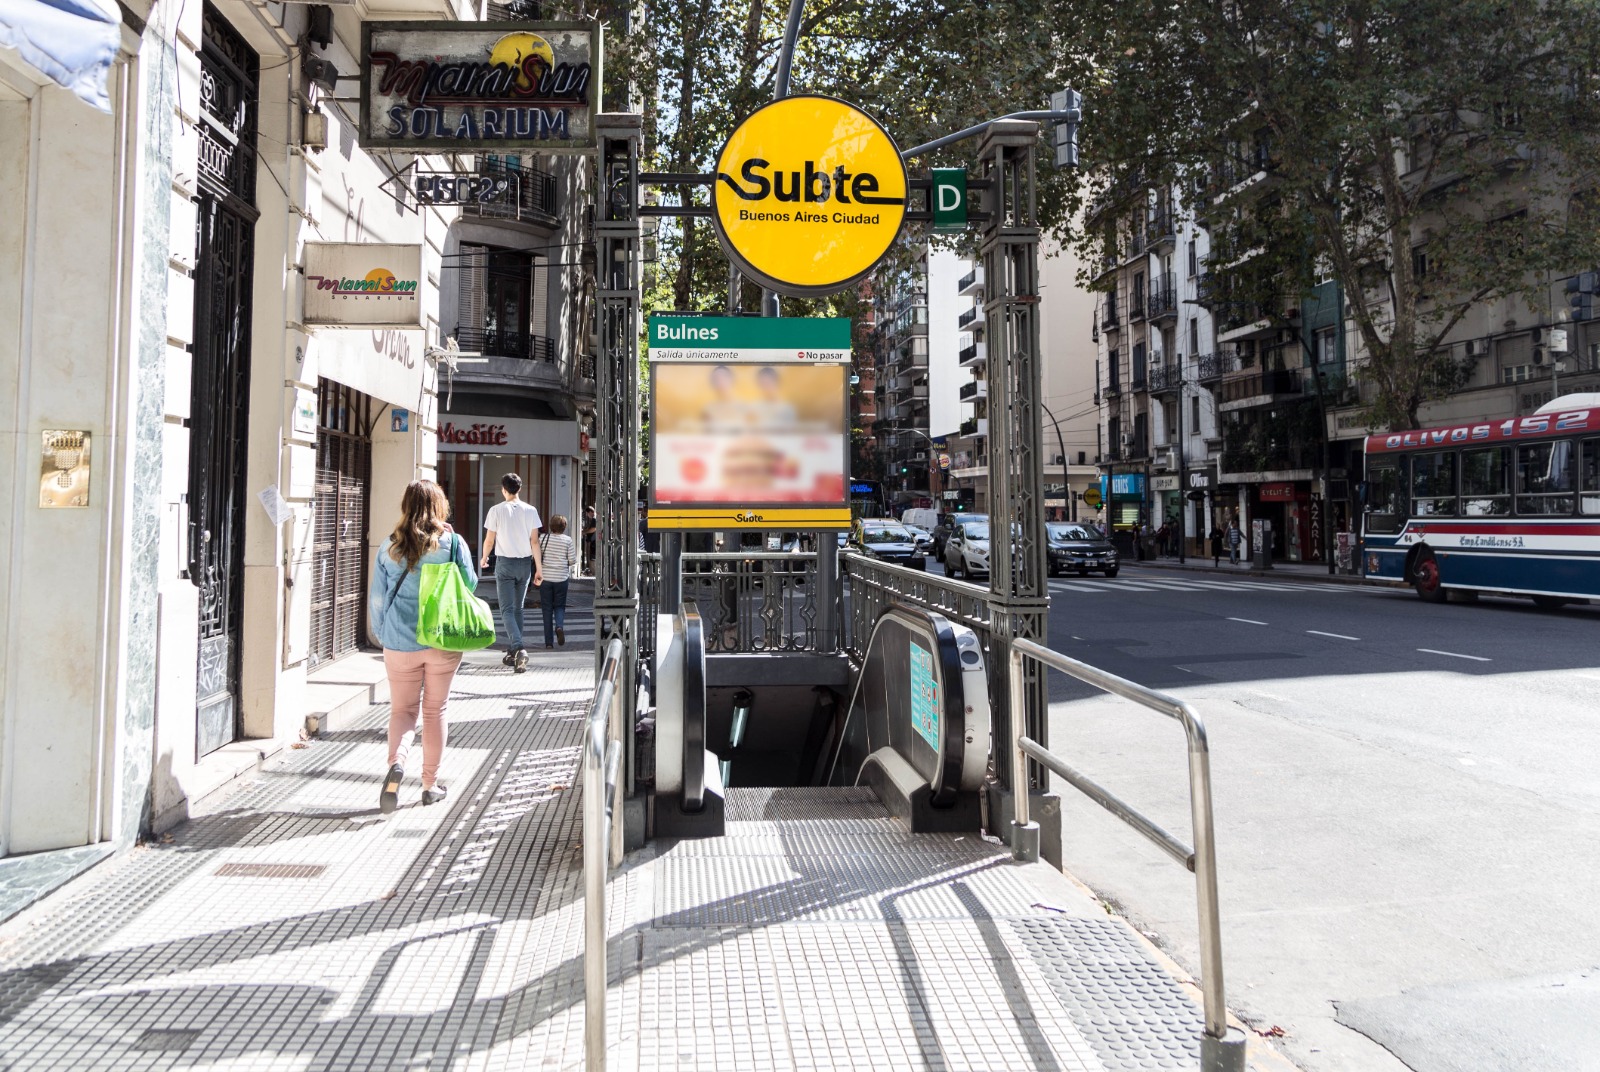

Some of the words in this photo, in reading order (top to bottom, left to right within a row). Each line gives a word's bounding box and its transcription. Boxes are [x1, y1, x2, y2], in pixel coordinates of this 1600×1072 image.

[513, 54, 591, 98] Sun
[387, 106, 571, 139] SOLARIUM
[741, 158, 880, 204] Subte
[938, 184, 961, 211] D
[739, 209, 790, 222] Buenos
[794, 211, 828, 223] Aires
[832, 212, 880, 225] Ciudad
[381, 277, 418, 292] Sun
[657, 323, 719, 340] Bulnes
[657, 350, 683, 359] Salida
[686, 350, 739, 359] únicamente
[806, 352, 819, 360] No
[820, 352, 844, 361] pasar
[437, 421, 508, 446] Medifé
[1386, 425, 1491, 449] OLIVOS
[1500, 410, 1590, 437] 152
[1310, 493, 1320, 557] NAZARIA
